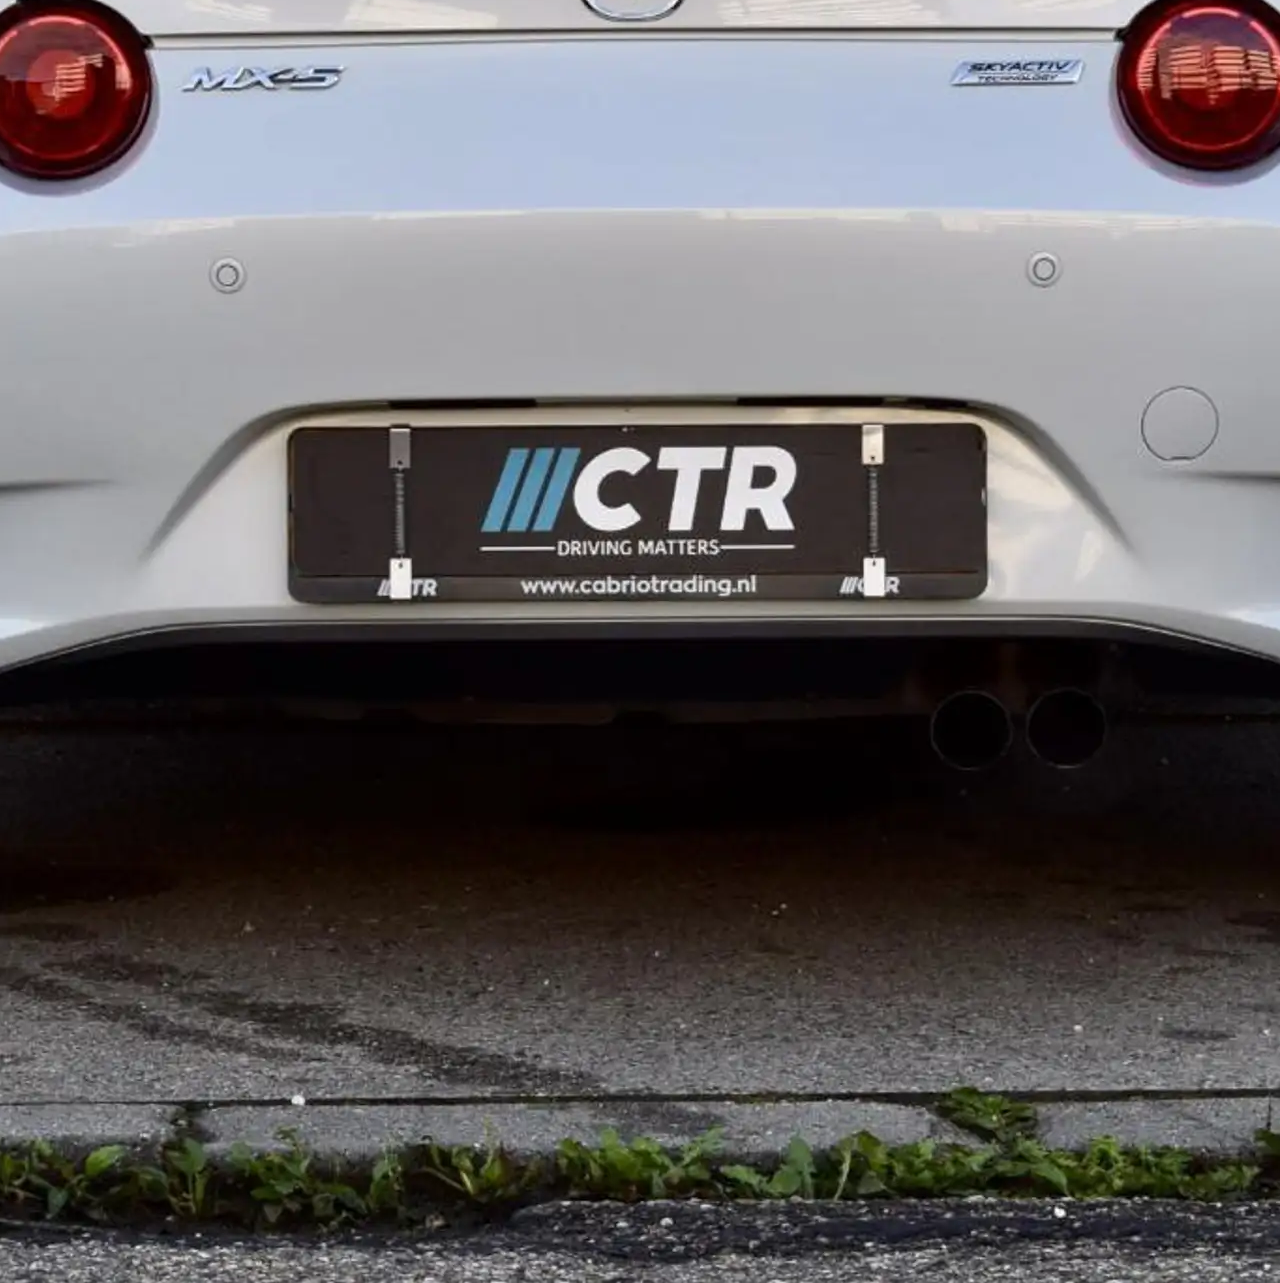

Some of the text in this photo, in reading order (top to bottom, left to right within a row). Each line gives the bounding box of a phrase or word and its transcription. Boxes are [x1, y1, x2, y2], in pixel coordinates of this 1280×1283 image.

[969, 60, 1073, 73] SKYACTIV
[573, 446, 797, 532] CTR
[556, 538, 721, 556] DRIVING MATTERS
[520, 575, 757, 597] www.cabriotrading.nl
